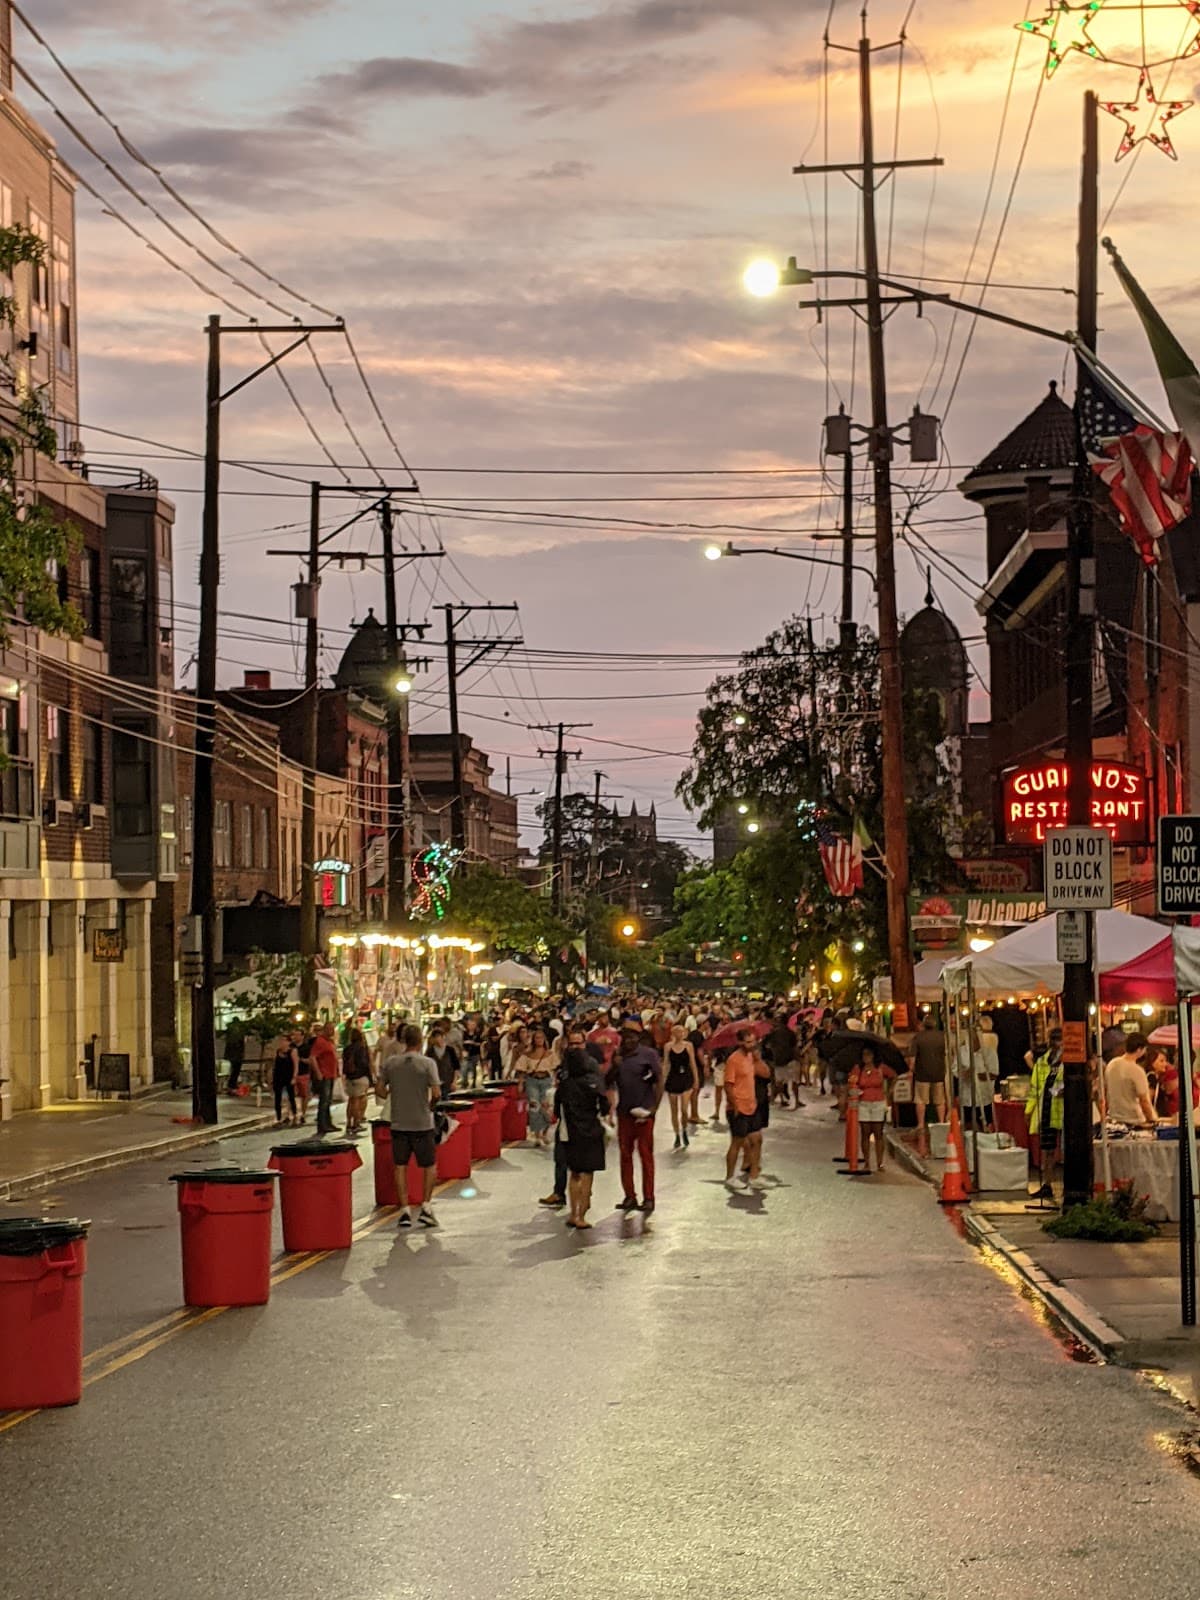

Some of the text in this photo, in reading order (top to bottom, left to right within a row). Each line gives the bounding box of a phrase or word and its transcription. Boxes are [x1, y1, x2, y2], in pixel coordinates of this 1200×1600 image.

[1010, 800, 1144, 821] RESTRANT
[1175, 825, 1194, 843] DO
[1052, 838, 1104, 856] DO NOT
[1171, 845, 1197, 863] NOT
[1054, 862, 1103, 880] BLOCK
[1052, 885, 1105, 899] DRIVEWAY
